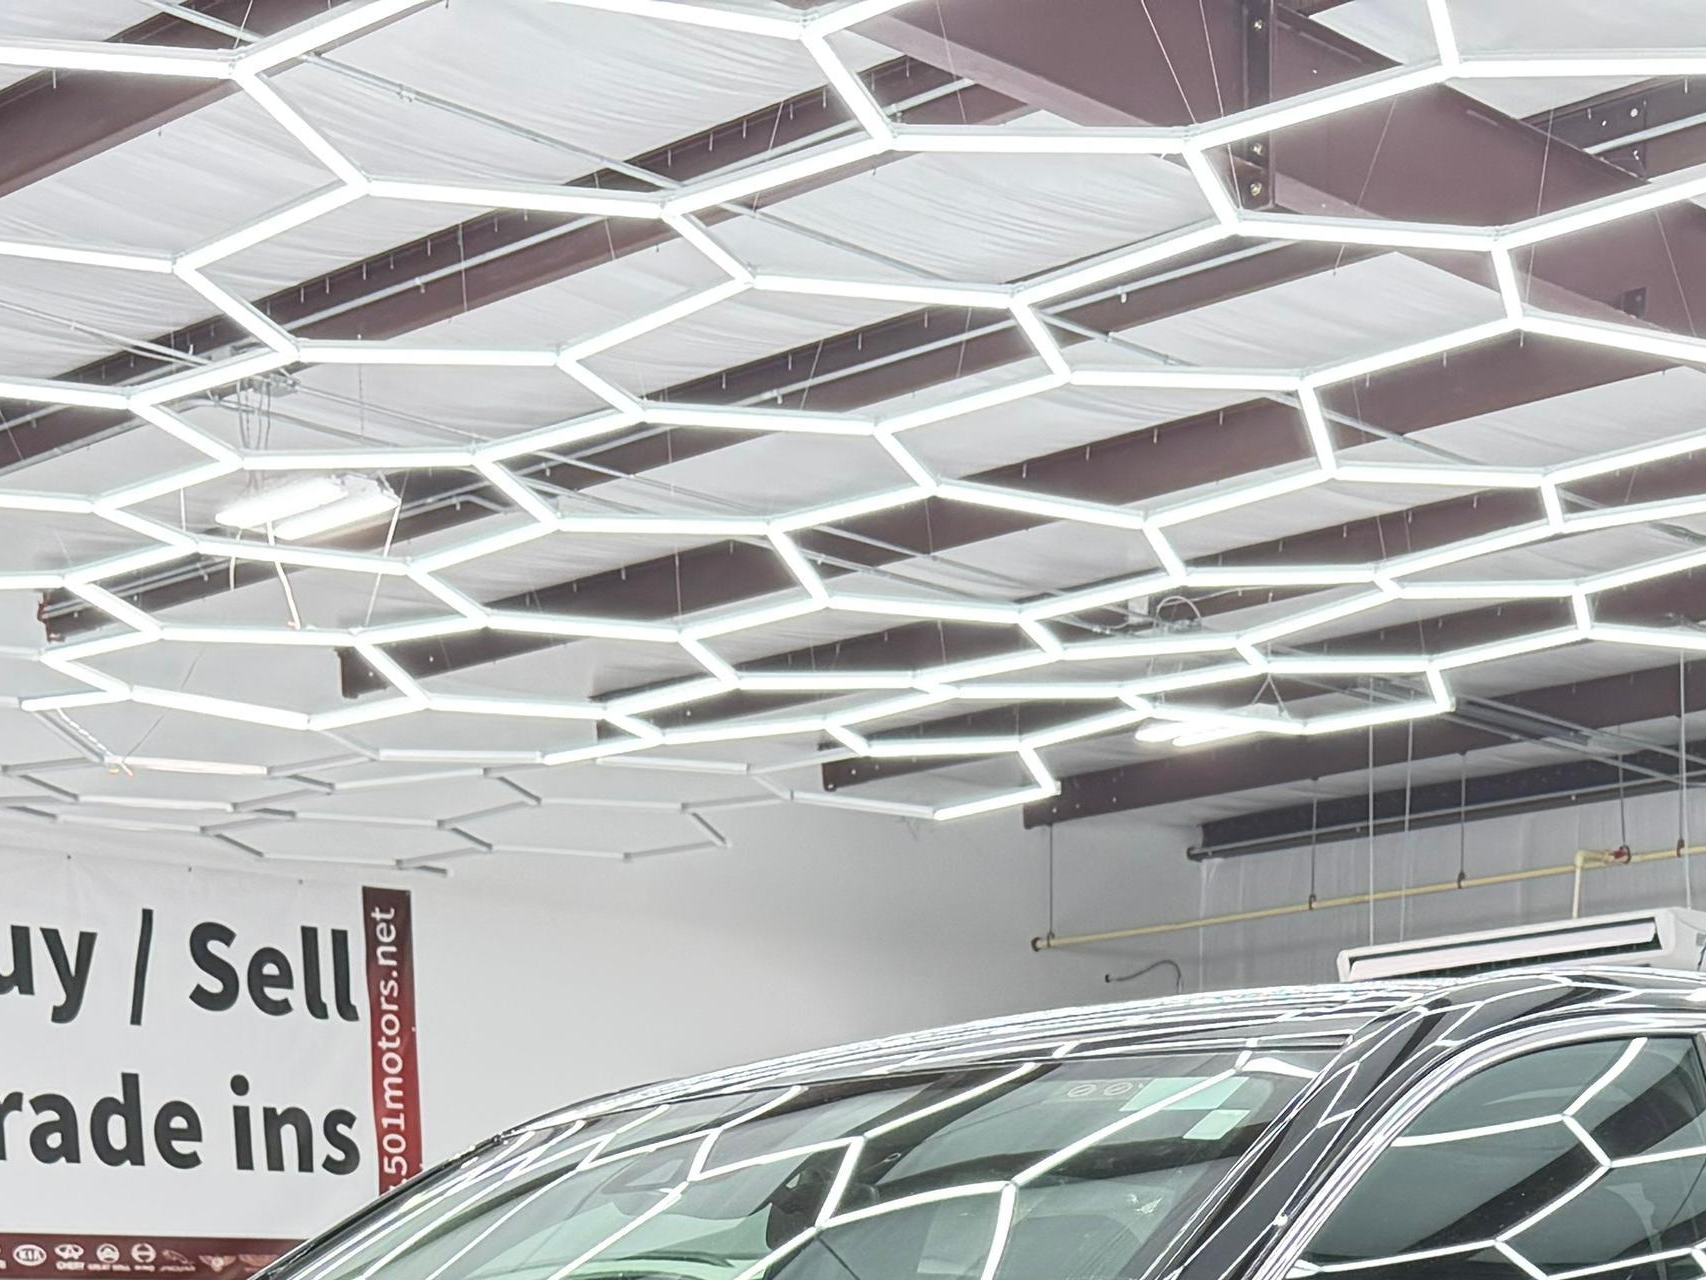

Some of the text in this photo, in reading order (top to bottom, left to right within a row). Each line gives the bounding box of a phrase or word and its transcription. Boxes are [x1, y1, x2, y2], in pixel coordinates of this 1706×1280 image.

[130, 908, 154, 1026] /
[189, 920, 360, 1023] Sell
[229, 1073, 363, 1176] ins
